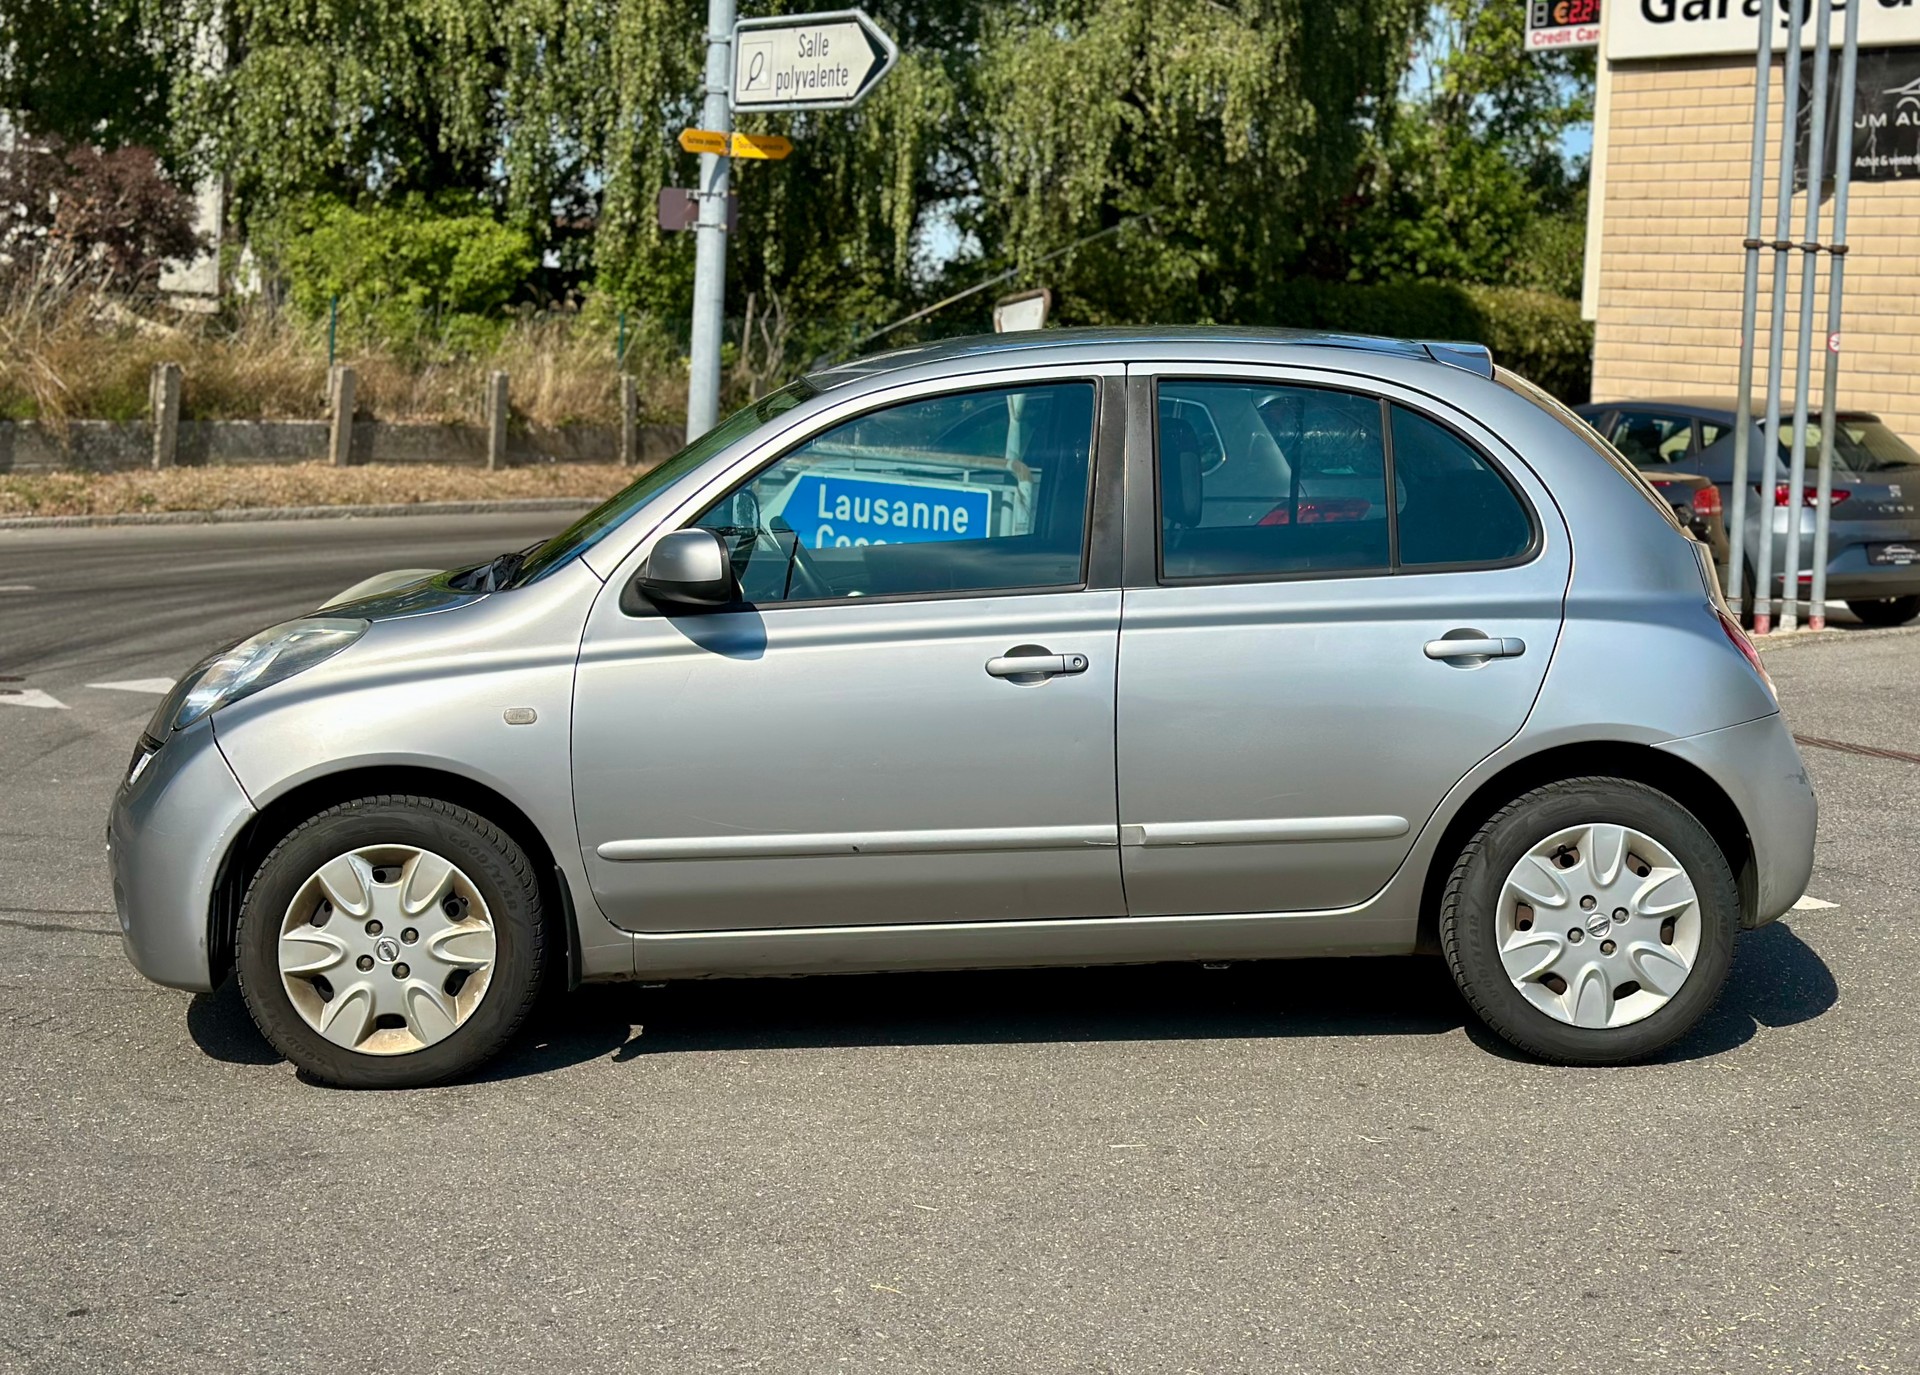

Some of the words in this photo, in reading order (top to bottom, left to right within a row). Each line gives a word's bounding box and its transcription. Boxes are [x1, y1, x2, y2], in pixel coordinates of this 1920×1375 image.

[798, 32, 829, 59] Salle
[1532, 30, 1571, 46] Credit
[776, 62, 849, 97] polyvalente
[1854, 112, 1887, 129] JM
[817, 483, 969, 534] Lausanne
